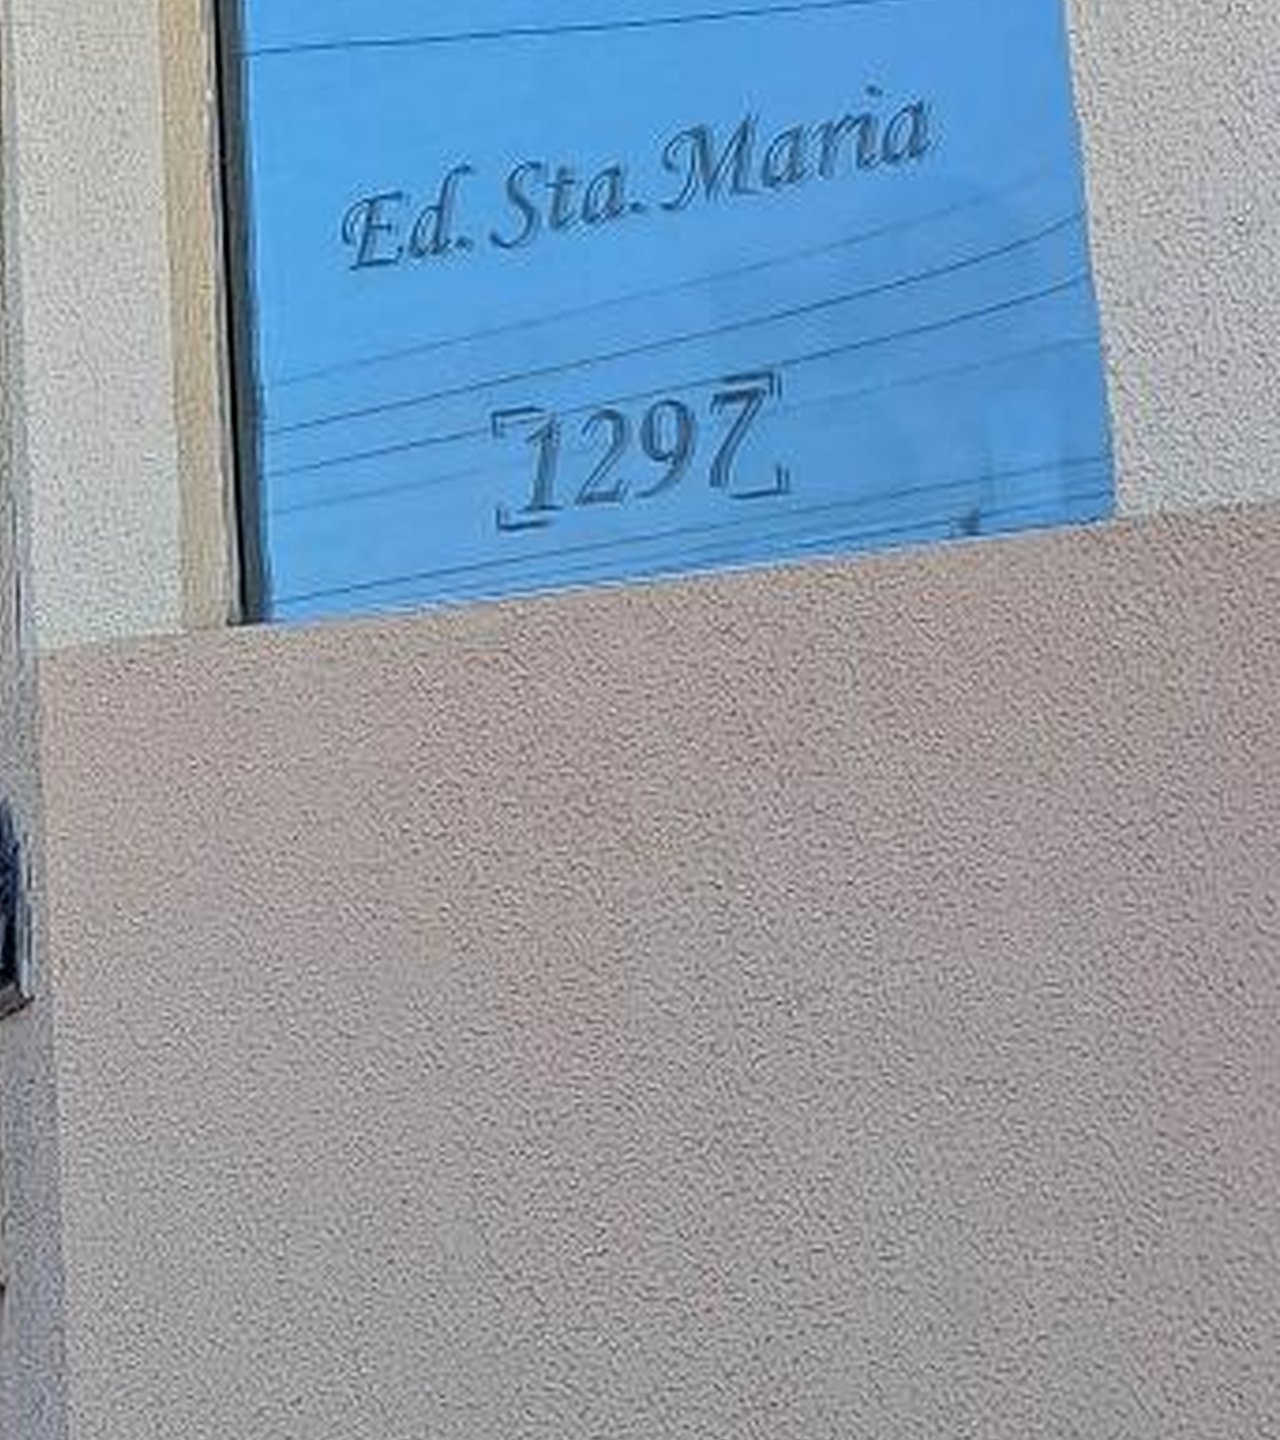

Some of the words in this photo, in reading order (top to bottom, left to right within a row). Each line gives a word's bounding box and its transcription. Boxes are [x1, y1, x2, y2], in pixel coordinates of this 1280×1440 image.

[341, 163, 474, 271] Ed.
[488, 160, 647, 250] Sta.
[524, 385, 770, 513] 1297
